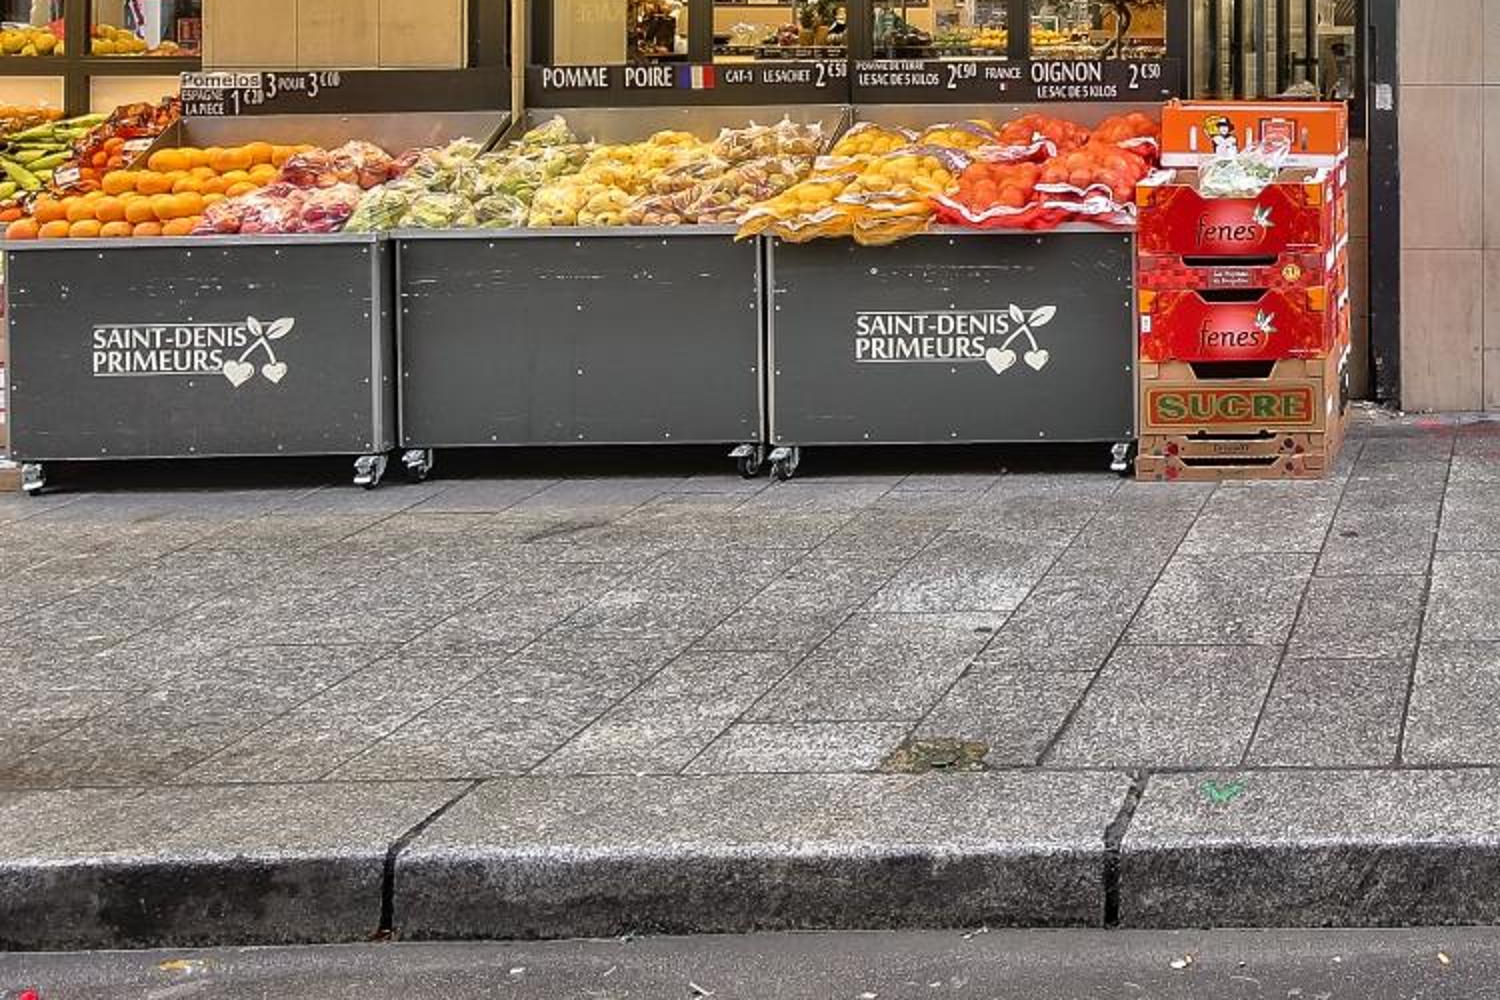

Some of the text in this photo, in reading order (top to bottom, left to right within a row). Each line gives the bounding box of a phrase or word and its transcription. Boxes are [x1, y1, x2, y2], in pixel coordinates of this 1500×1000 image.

[182, 73, 260, 88] Pomelos
[543, 66, 609, 88] POMME
[625, 66, 673, 87] POIRE
[725, 70, 753, 83] CAT-1
[985, 66, 1022, 79] FRANCE
[1030, 61, 1102, 83] OIGNON
[181, 89, 224, 101] ESPAGNE
[265, 73, 277, 98] 3
[278, 77, 306, 90] POUR
[185, 103, 198, 115] LA
[856, 313, 1009, 336] SAINT-DENIS
[93, 326, 248, 349] SAINT-DENIS
[855, 336, 986, 359] PRIMEURS
[93, 349, 224, 373] PRIMEURS
[1156, 391, 1307, 421] SUCRE
